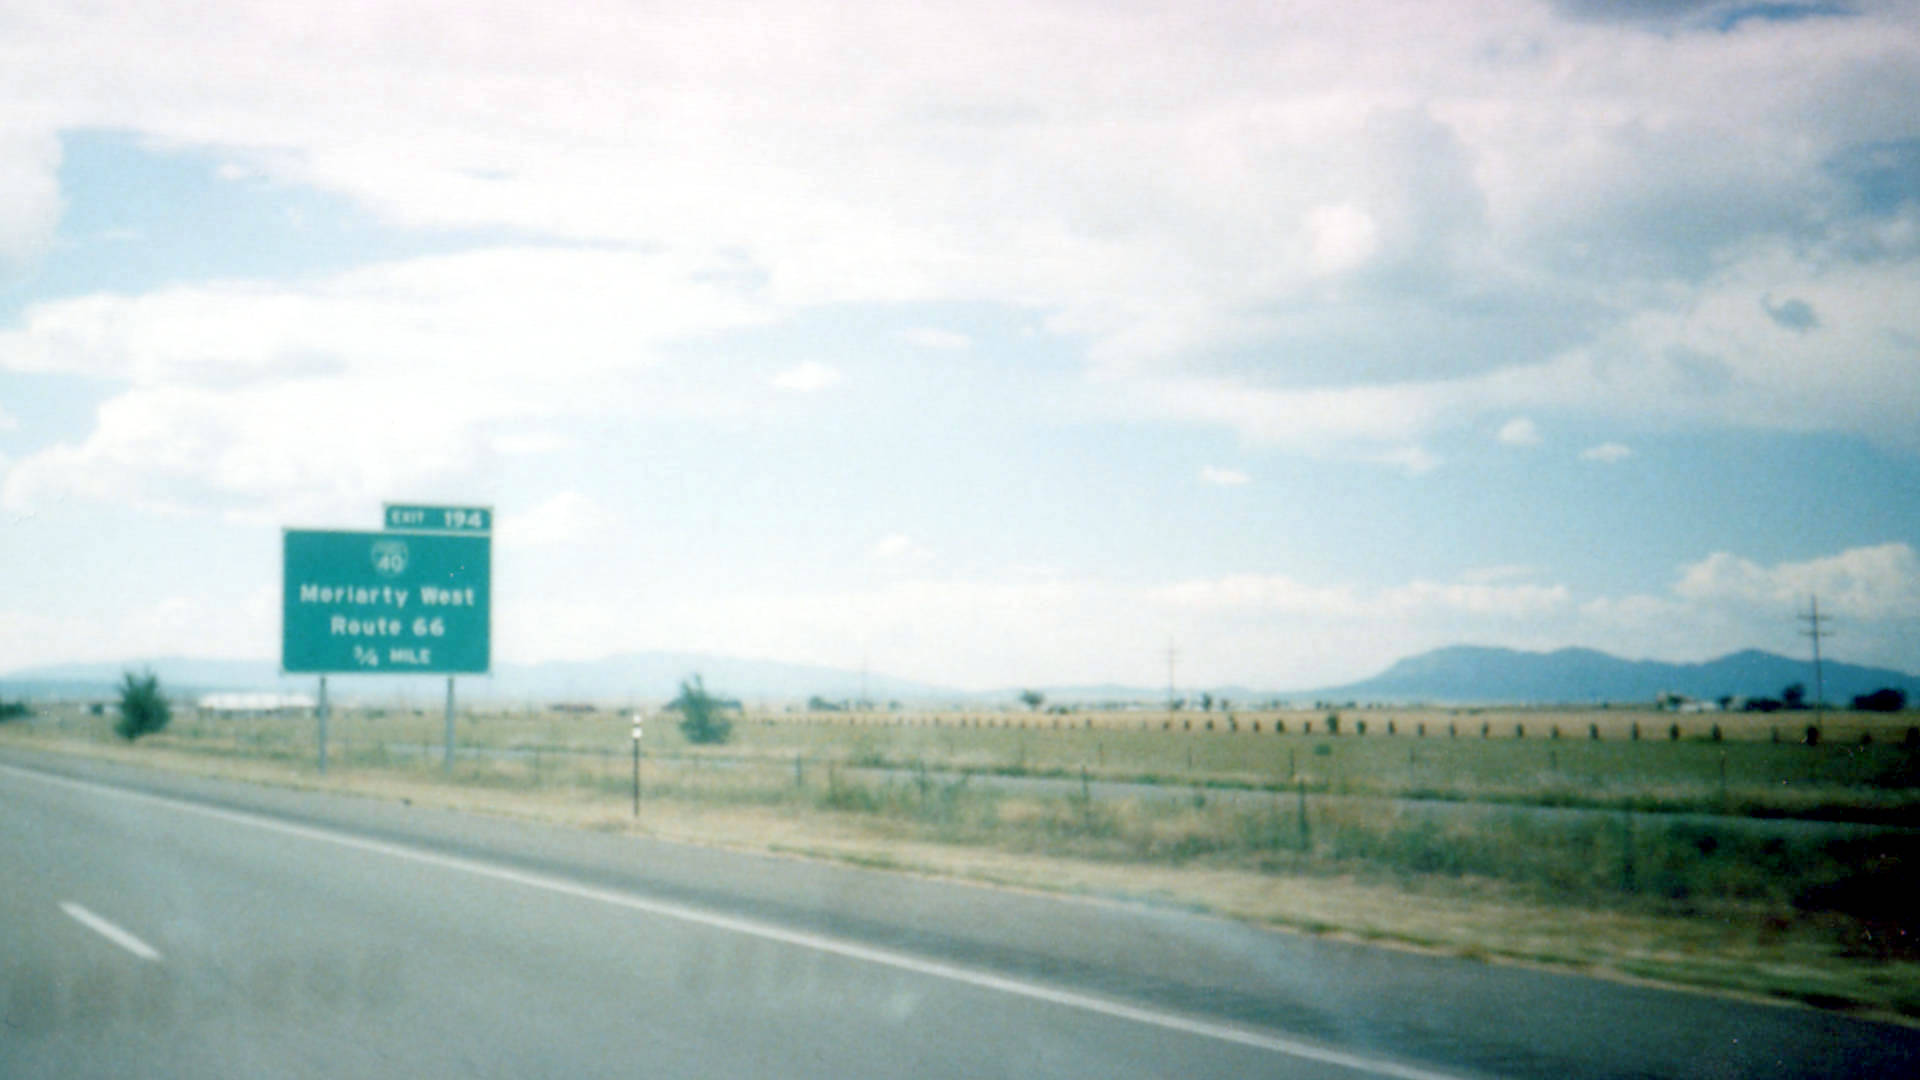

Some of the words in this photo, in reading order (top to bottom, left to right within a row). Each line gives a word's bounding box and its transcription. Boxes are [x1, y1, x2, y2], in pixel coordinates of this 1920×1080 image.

[391, 510, 424, 524] EXIT
[444, 510, 482, 528] 194
[377, 556, 403, 573] 40
[300, 584, 408, 608] Moriarty
[420, 587, 475, 606] West
[330, 615, 402, 636] Route
[412, 617, 445, 636] 66
[389, 649, 431, 665] MILE
